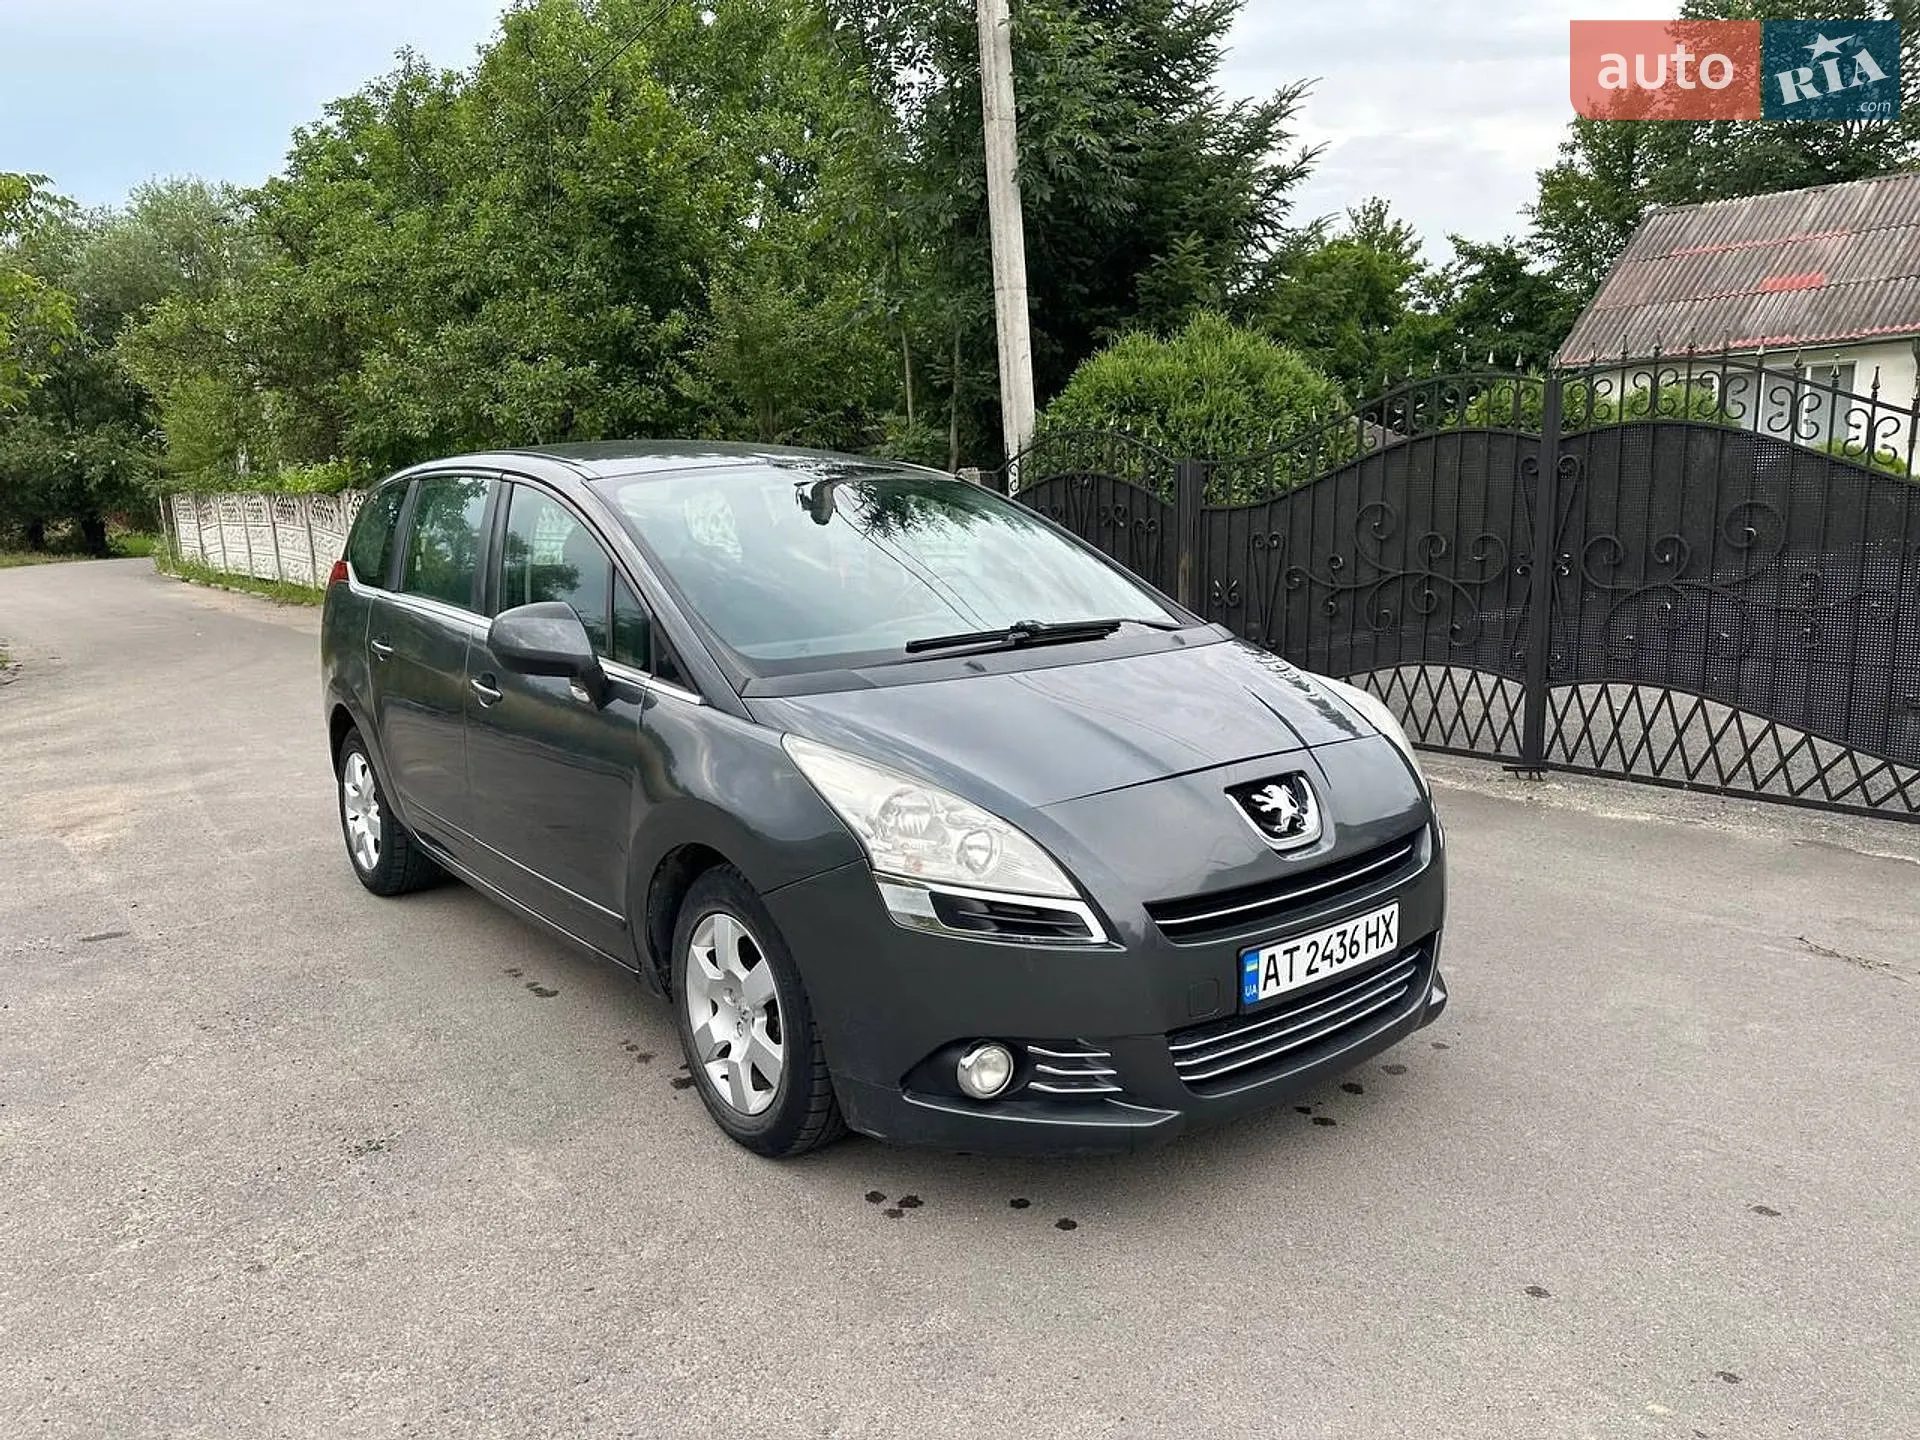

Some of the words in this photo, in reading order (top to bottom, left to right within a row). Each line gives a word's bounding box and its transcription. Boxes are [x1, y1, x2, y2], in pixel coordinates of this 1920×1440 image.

[1262, 945, 1301, 992] AT
[1305, 924, 1361, 977] 2436
[1364, 910, 1395, 955] HX
[1244, 984, 1258, 997] UA
